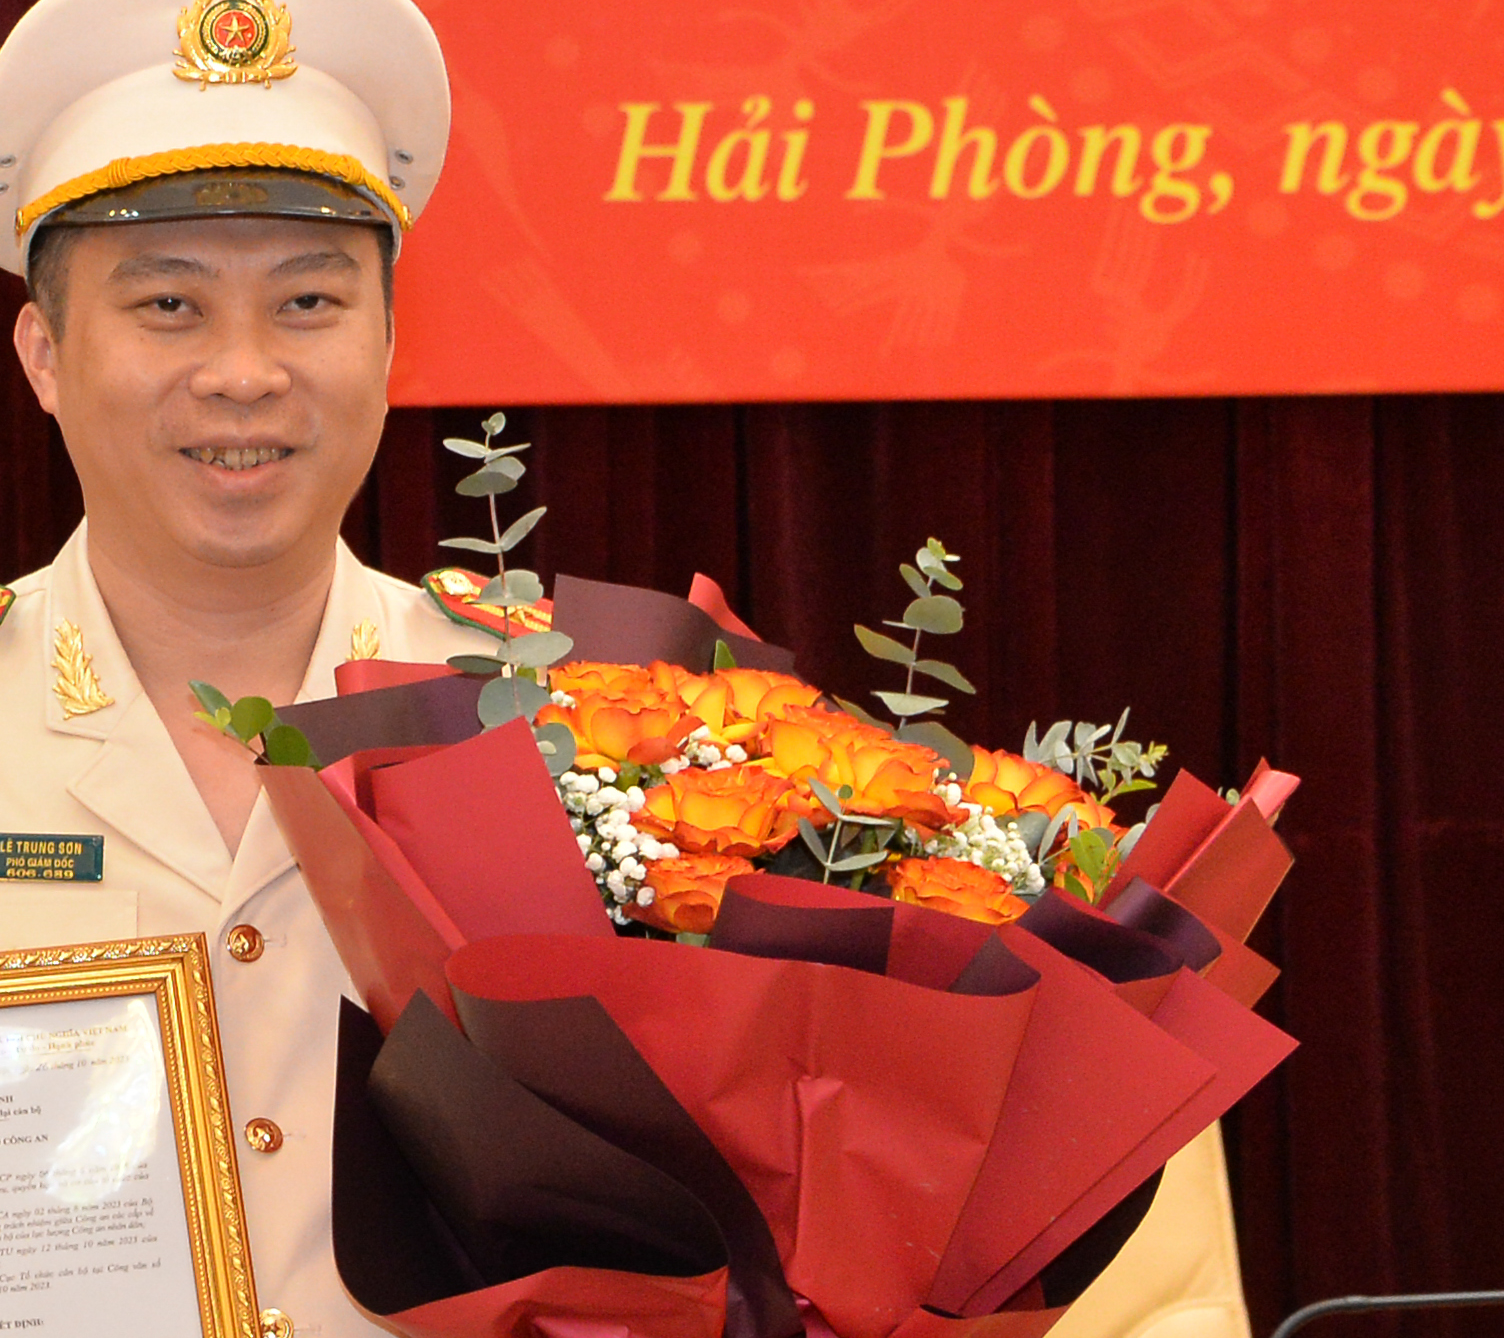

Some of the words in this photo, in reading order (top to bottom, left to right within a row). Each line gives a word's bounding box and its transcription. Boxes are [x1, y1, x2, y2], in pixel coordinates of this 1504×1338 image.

[603, 96, 815, 202] Hải
[847, 95, 1234, 224] Phòng,
[0, 837, 13, 853] LÊ
[16, 841, 55, 854] TRUNG
[59, 841, 82, 855] SƠN
[1, 1133, 33, 1146] CÔNG
[33, 1133, 49, 1143] AN
